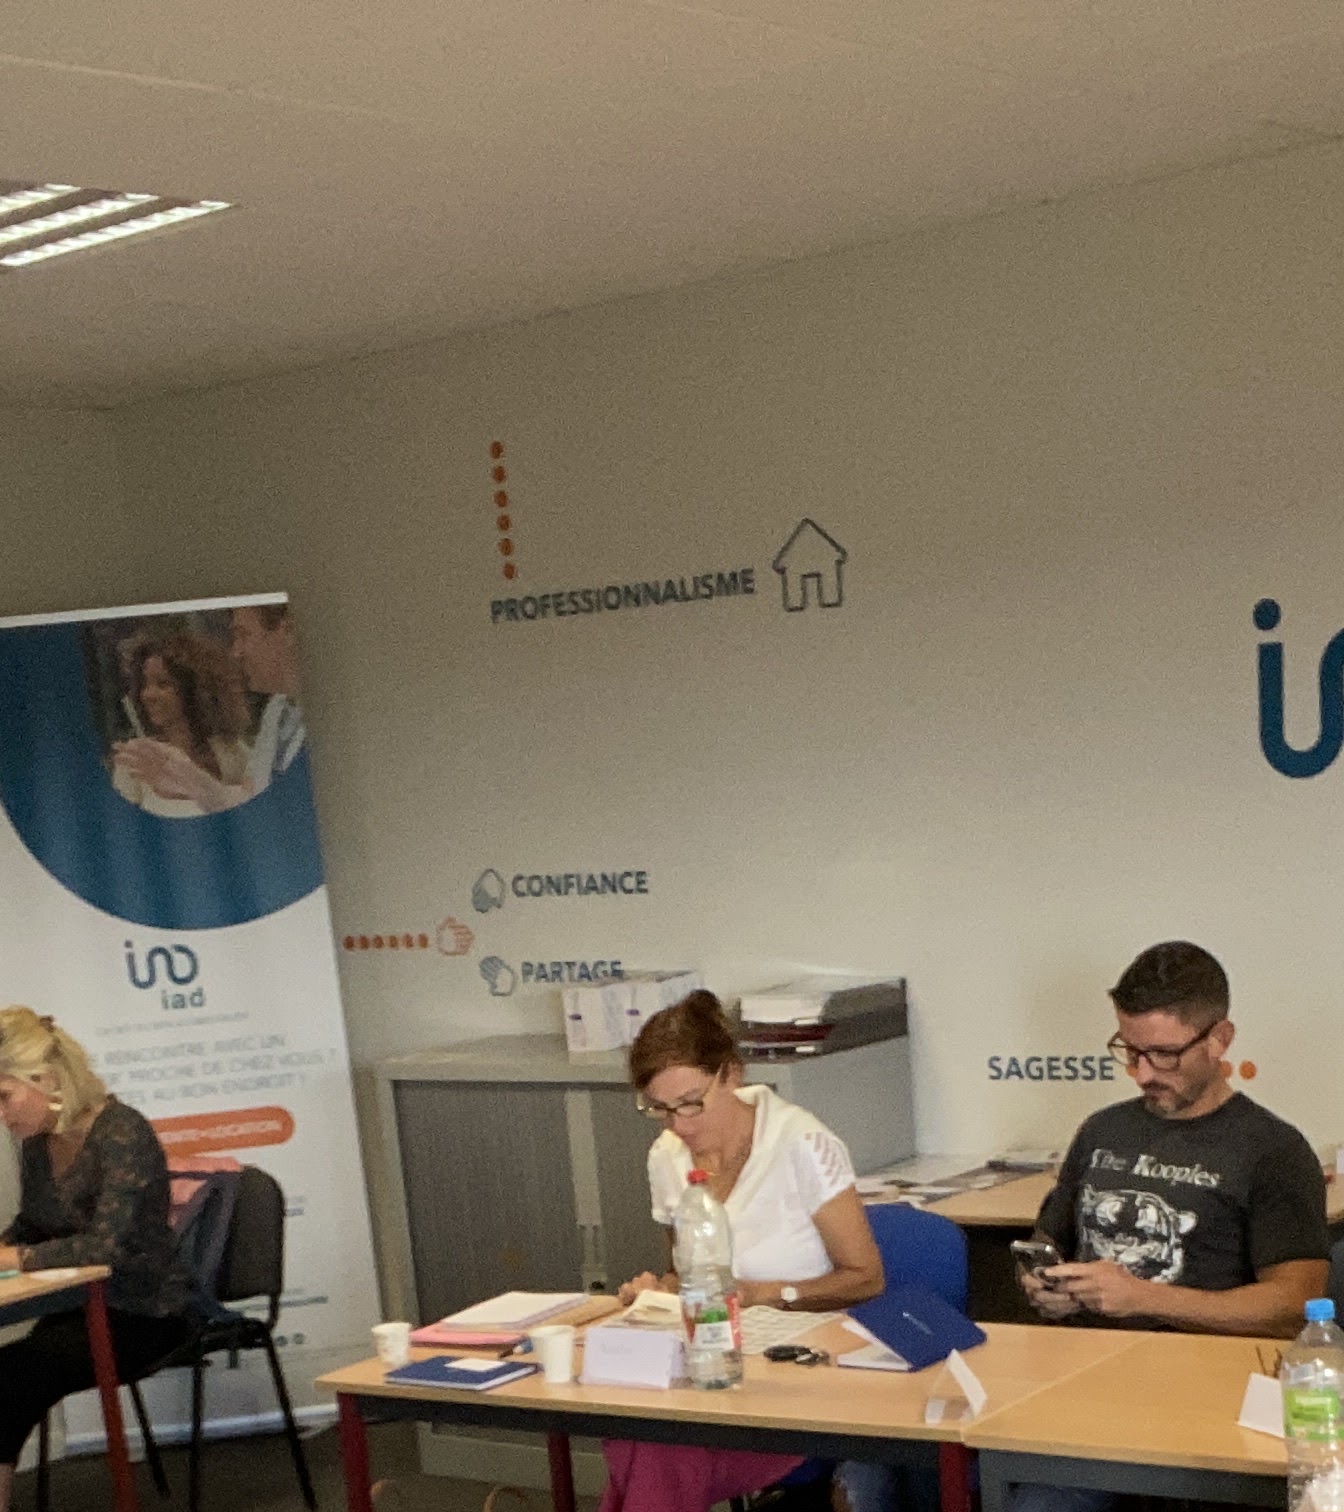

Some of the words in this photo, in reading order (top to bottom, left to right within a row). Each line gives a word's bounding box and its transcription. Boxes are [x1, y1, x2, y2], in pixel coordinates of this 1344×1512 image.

[490, 569, 756, 624] PROFESSIONNALISME
[511, 870, 649, 898] CONFIANCE
[521, 960, 625, 983] PARTAGE
[161, 987, 205, 1010] iad
[988, 1055, 1116, 1082] SAGESSE
[1132, 1153, 1221, 1188] Kooples
